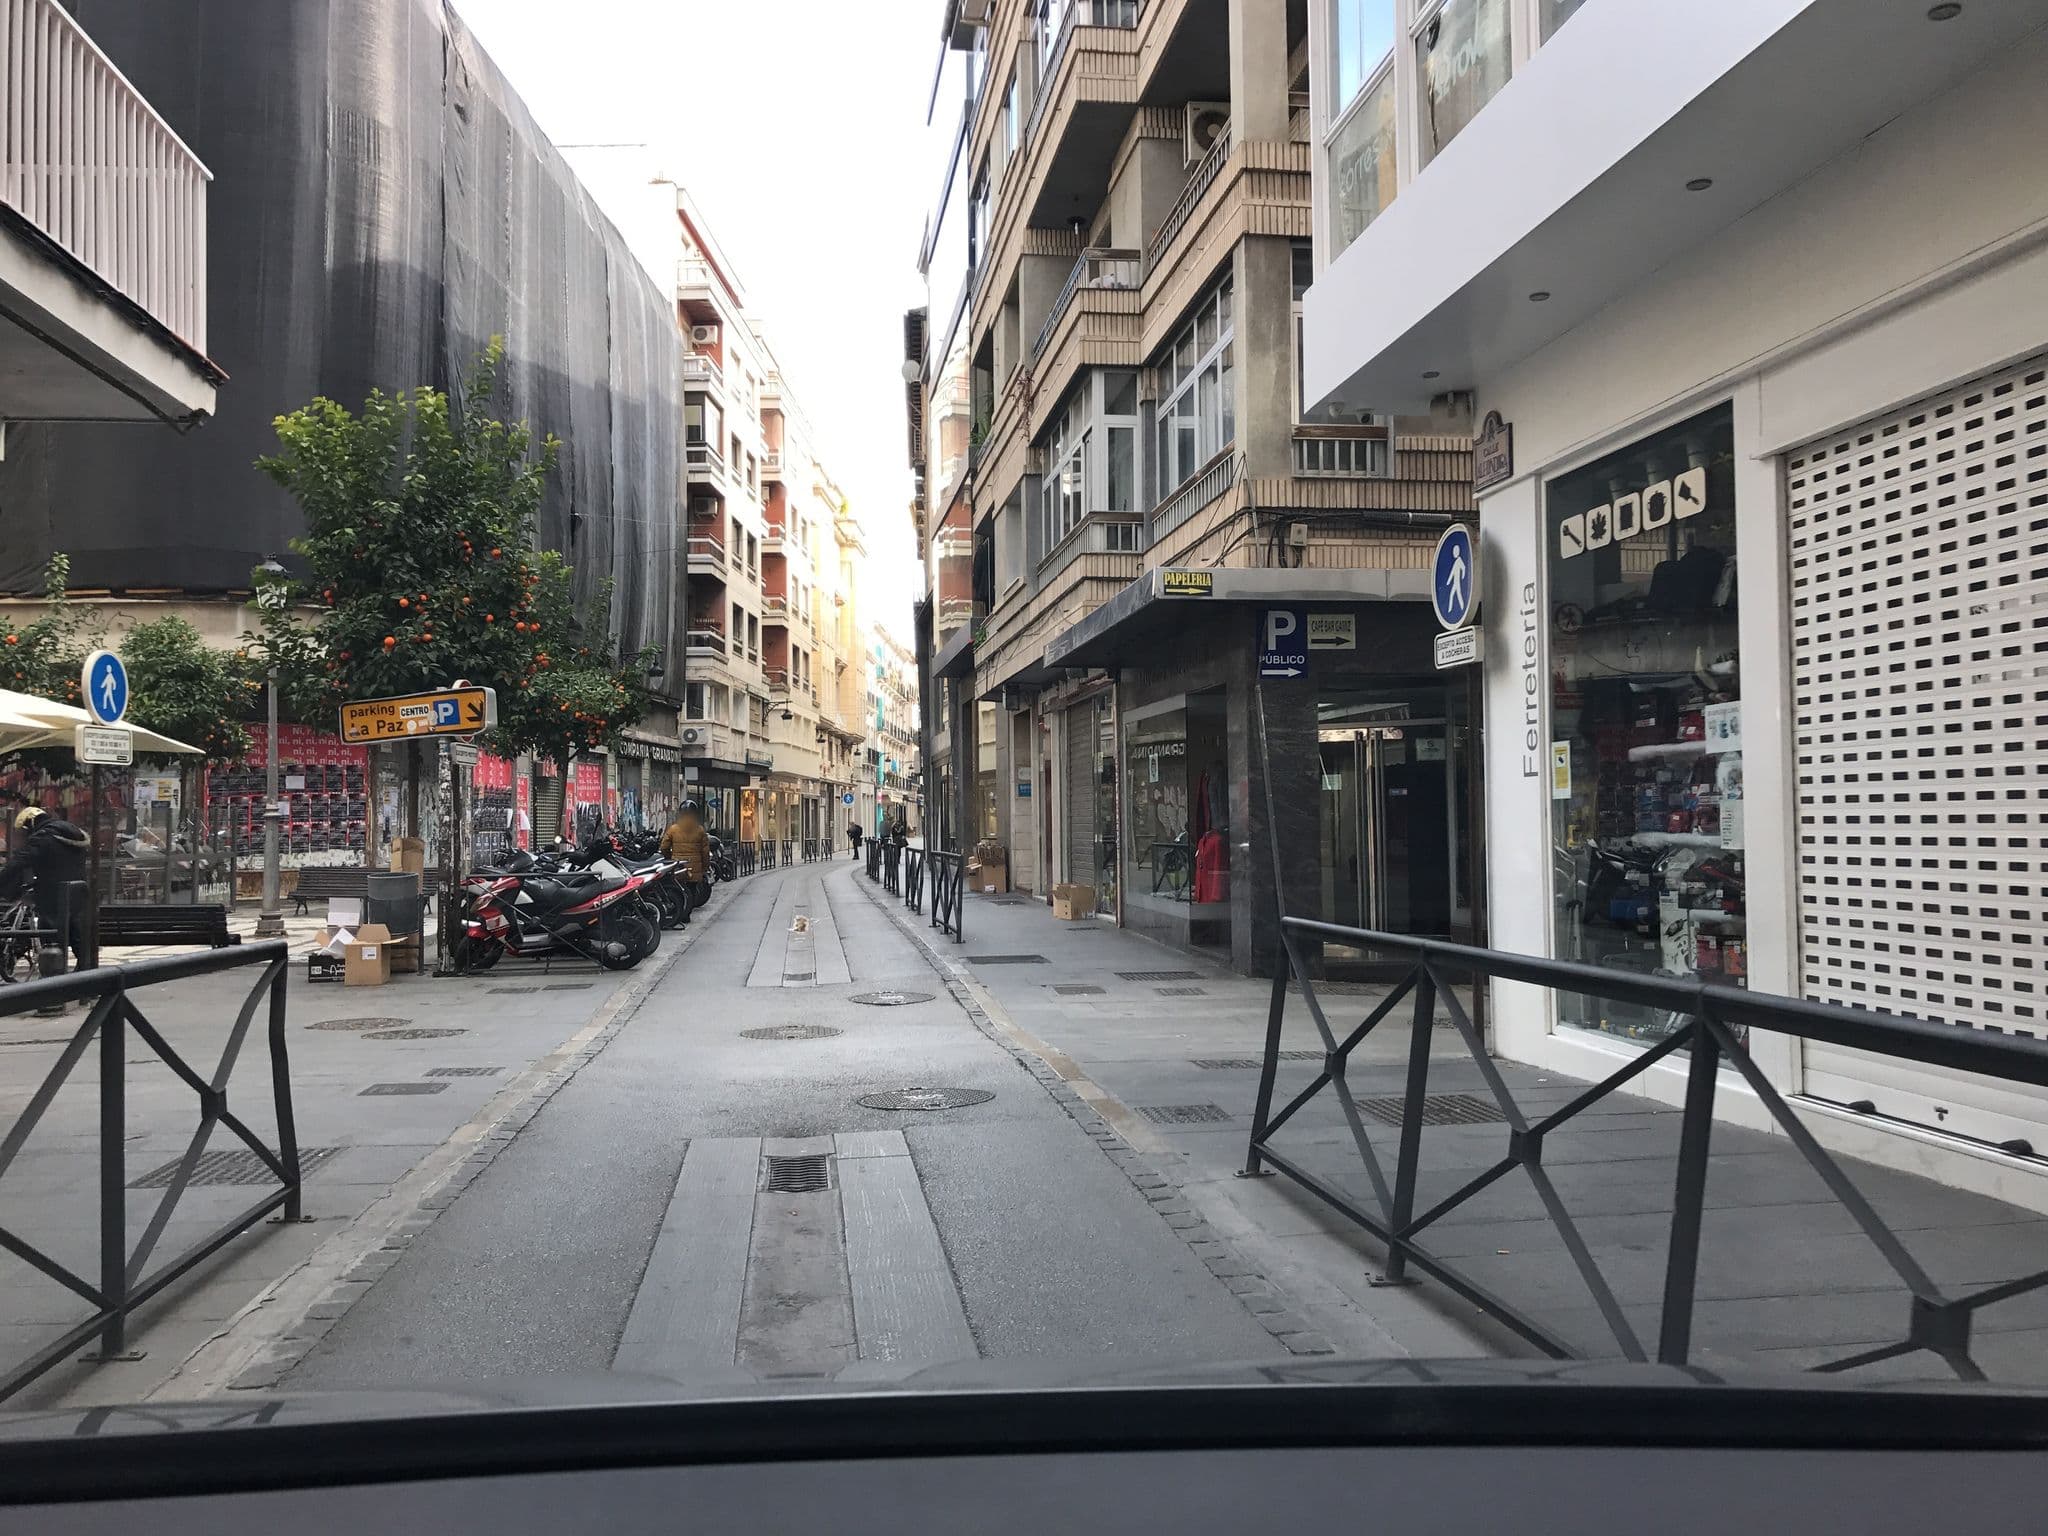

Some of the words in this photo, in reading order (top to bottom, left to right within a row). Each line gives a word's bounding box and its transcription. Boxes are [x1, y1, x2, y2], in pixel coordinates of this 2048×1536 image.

[1164, 572, 1212, 586] PAPELERIA
[1267, 610, 1296, 650] P
[1456, 634, 1474, 645] ACCESO
[1446, 645, 1470, 658] COCHERAS
[350, 704, 395, 719] parking
[401, 706, 429, 716] CENTRO
[376, 719, 404, 734] Paz
